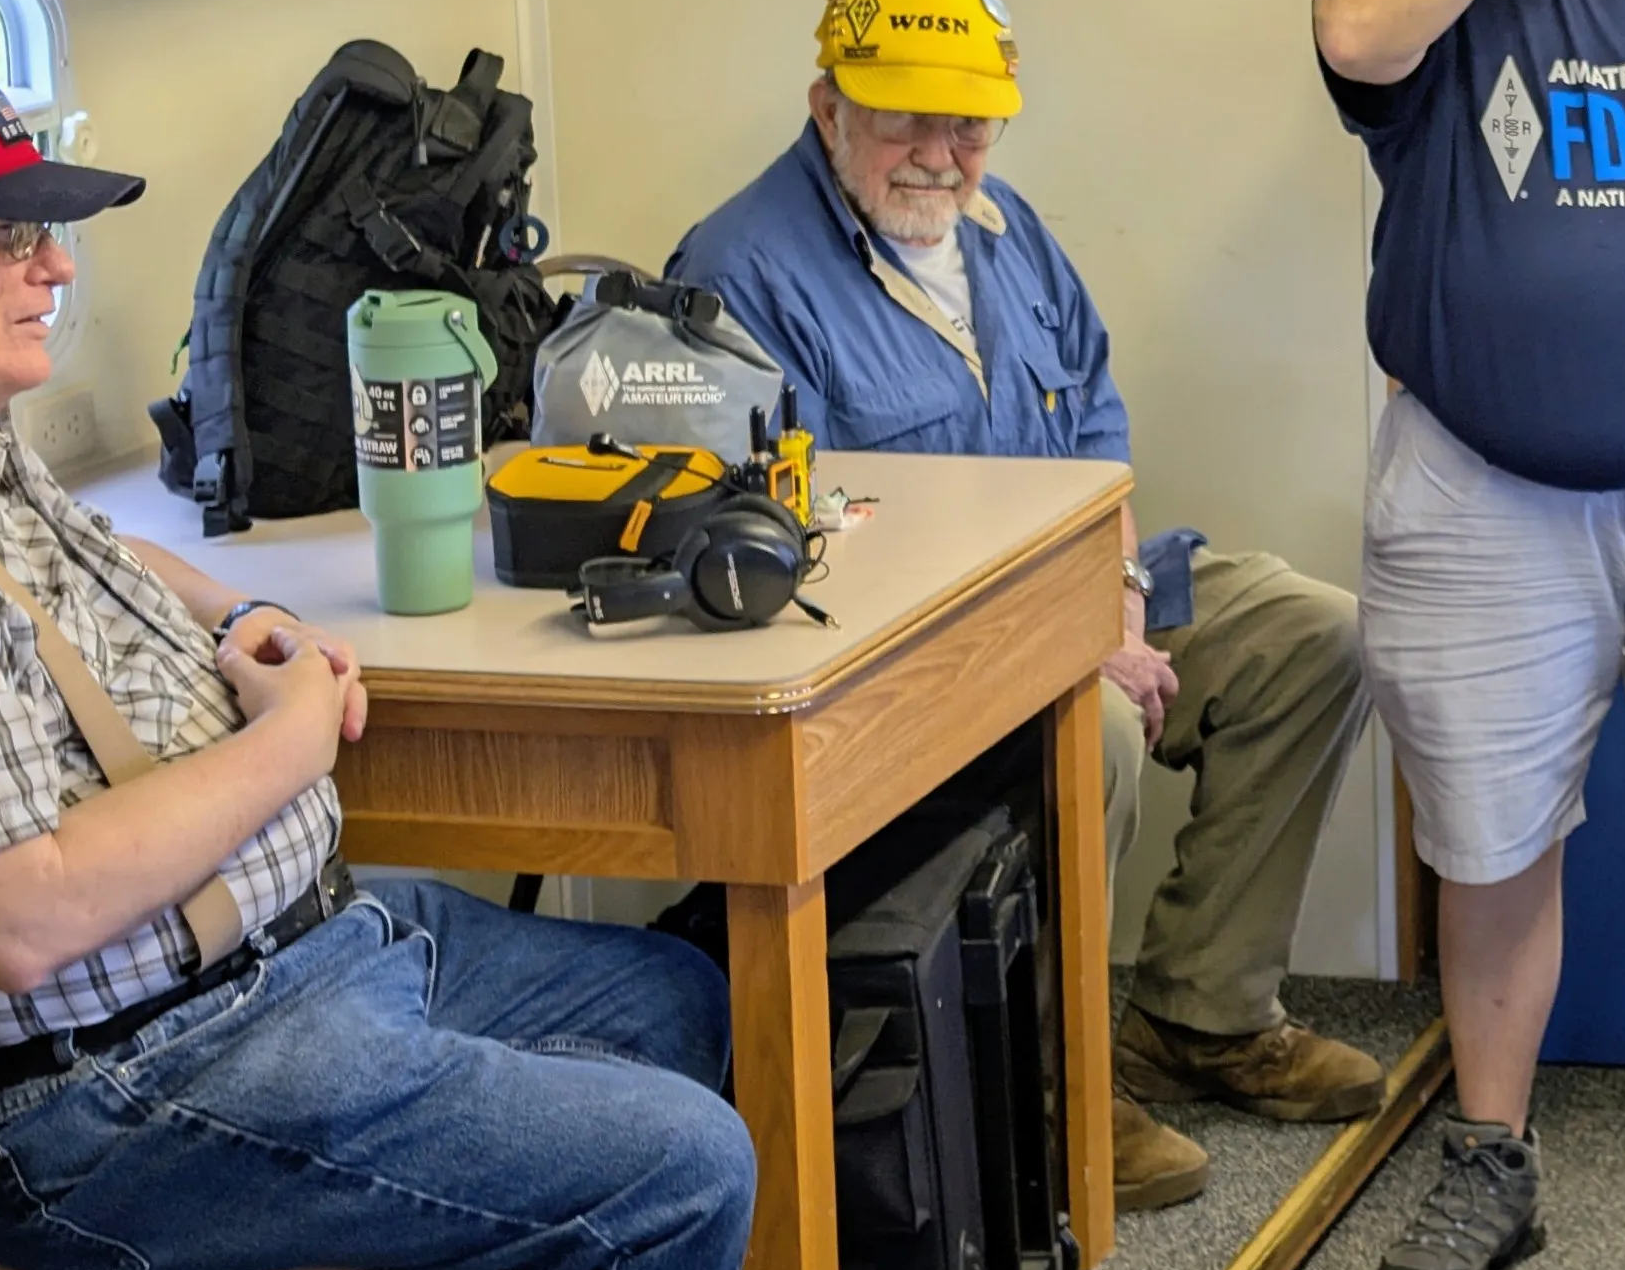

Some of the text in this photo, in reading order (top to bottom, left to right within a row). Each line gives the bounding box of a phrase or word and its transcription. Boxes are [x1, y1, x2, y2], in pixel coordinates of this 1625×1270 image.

[1555, 188, 1574, 208] A
[622, 361, 705, 384] ARRL
[368, 384, 382, 400] 40
[621, 390, 723, 405] AMATEUR RADIO
[362, 437, 398, 455] STRAW
